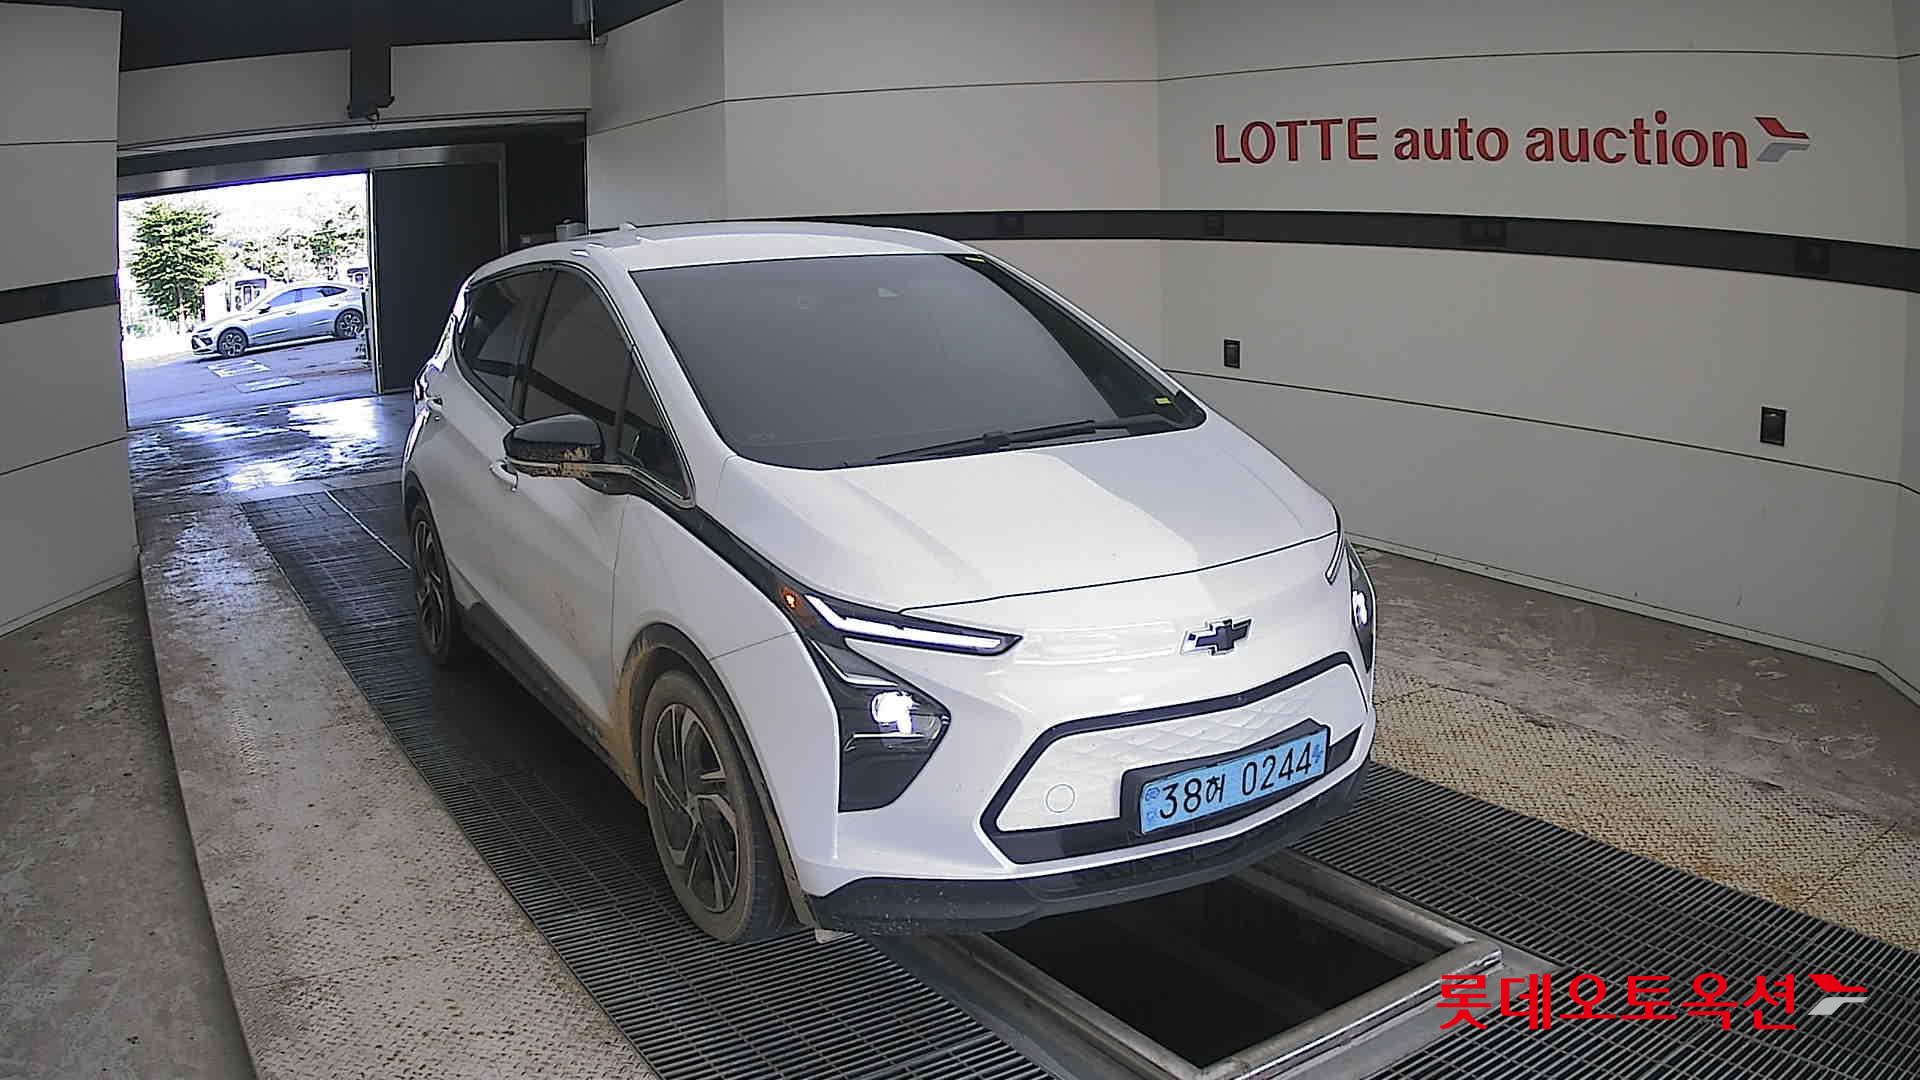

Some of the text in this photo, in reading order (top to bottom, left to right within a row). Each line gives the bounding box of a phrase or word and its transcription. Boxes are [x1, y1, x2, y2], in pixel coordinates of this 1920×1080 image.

[1215, 110, 1749, 169] LOTTE auto auction
[1241, 742, 1312, 795] 0244
